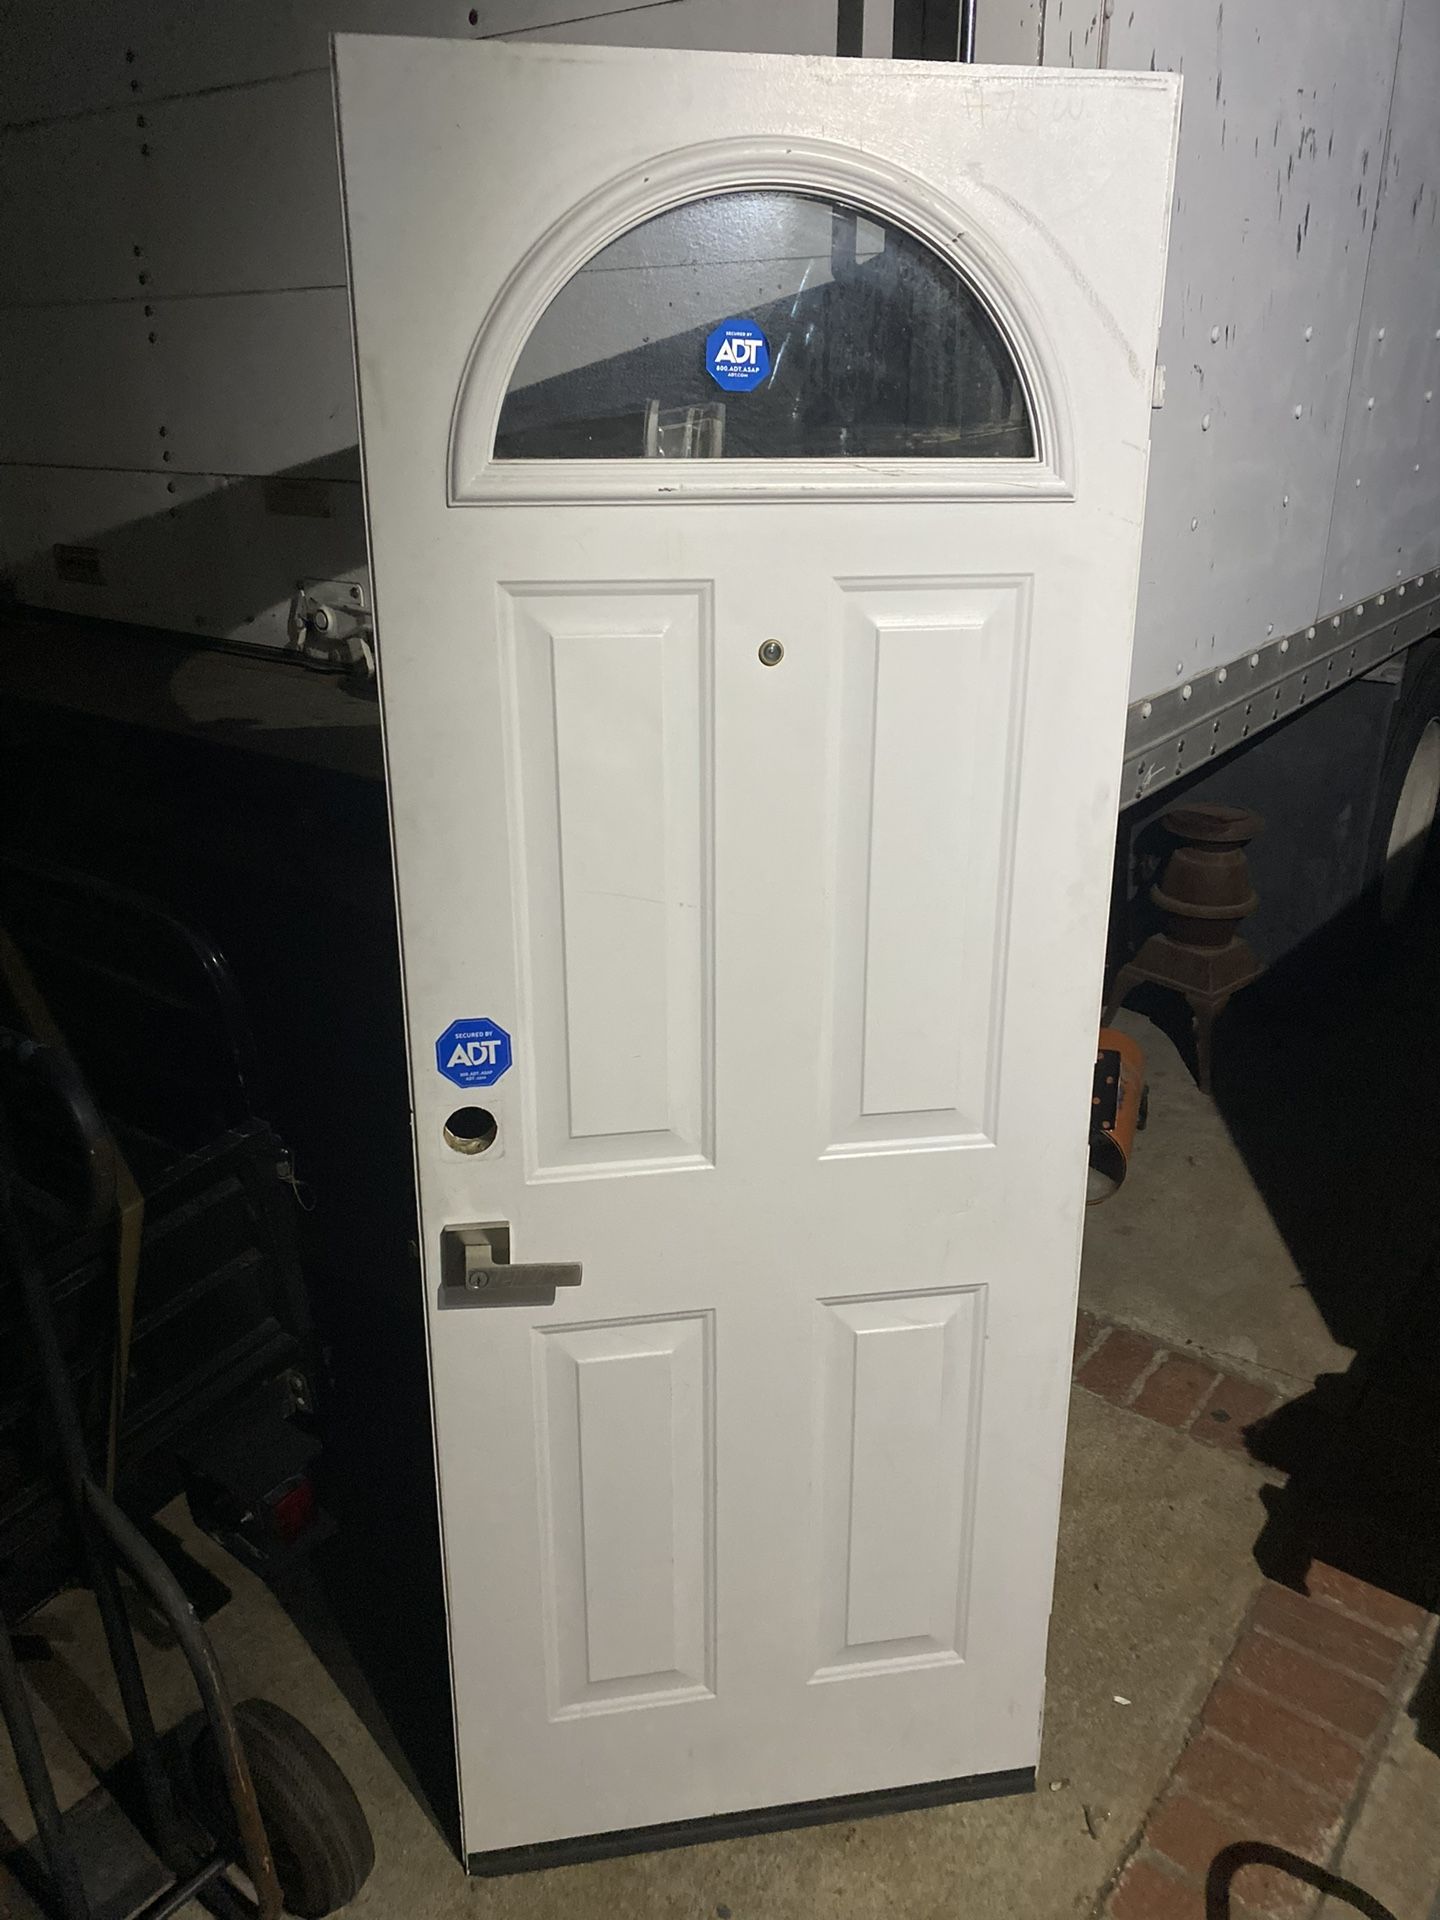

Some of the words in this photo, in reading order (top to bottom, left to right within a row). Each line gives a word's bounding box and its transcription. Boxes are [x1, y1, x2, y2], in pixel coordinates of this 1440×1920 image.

[714, 338, 763, 365] ADT
[455, 1031, 484, 1039] SECURED
[446, 1040, 501, 1068] ADT
